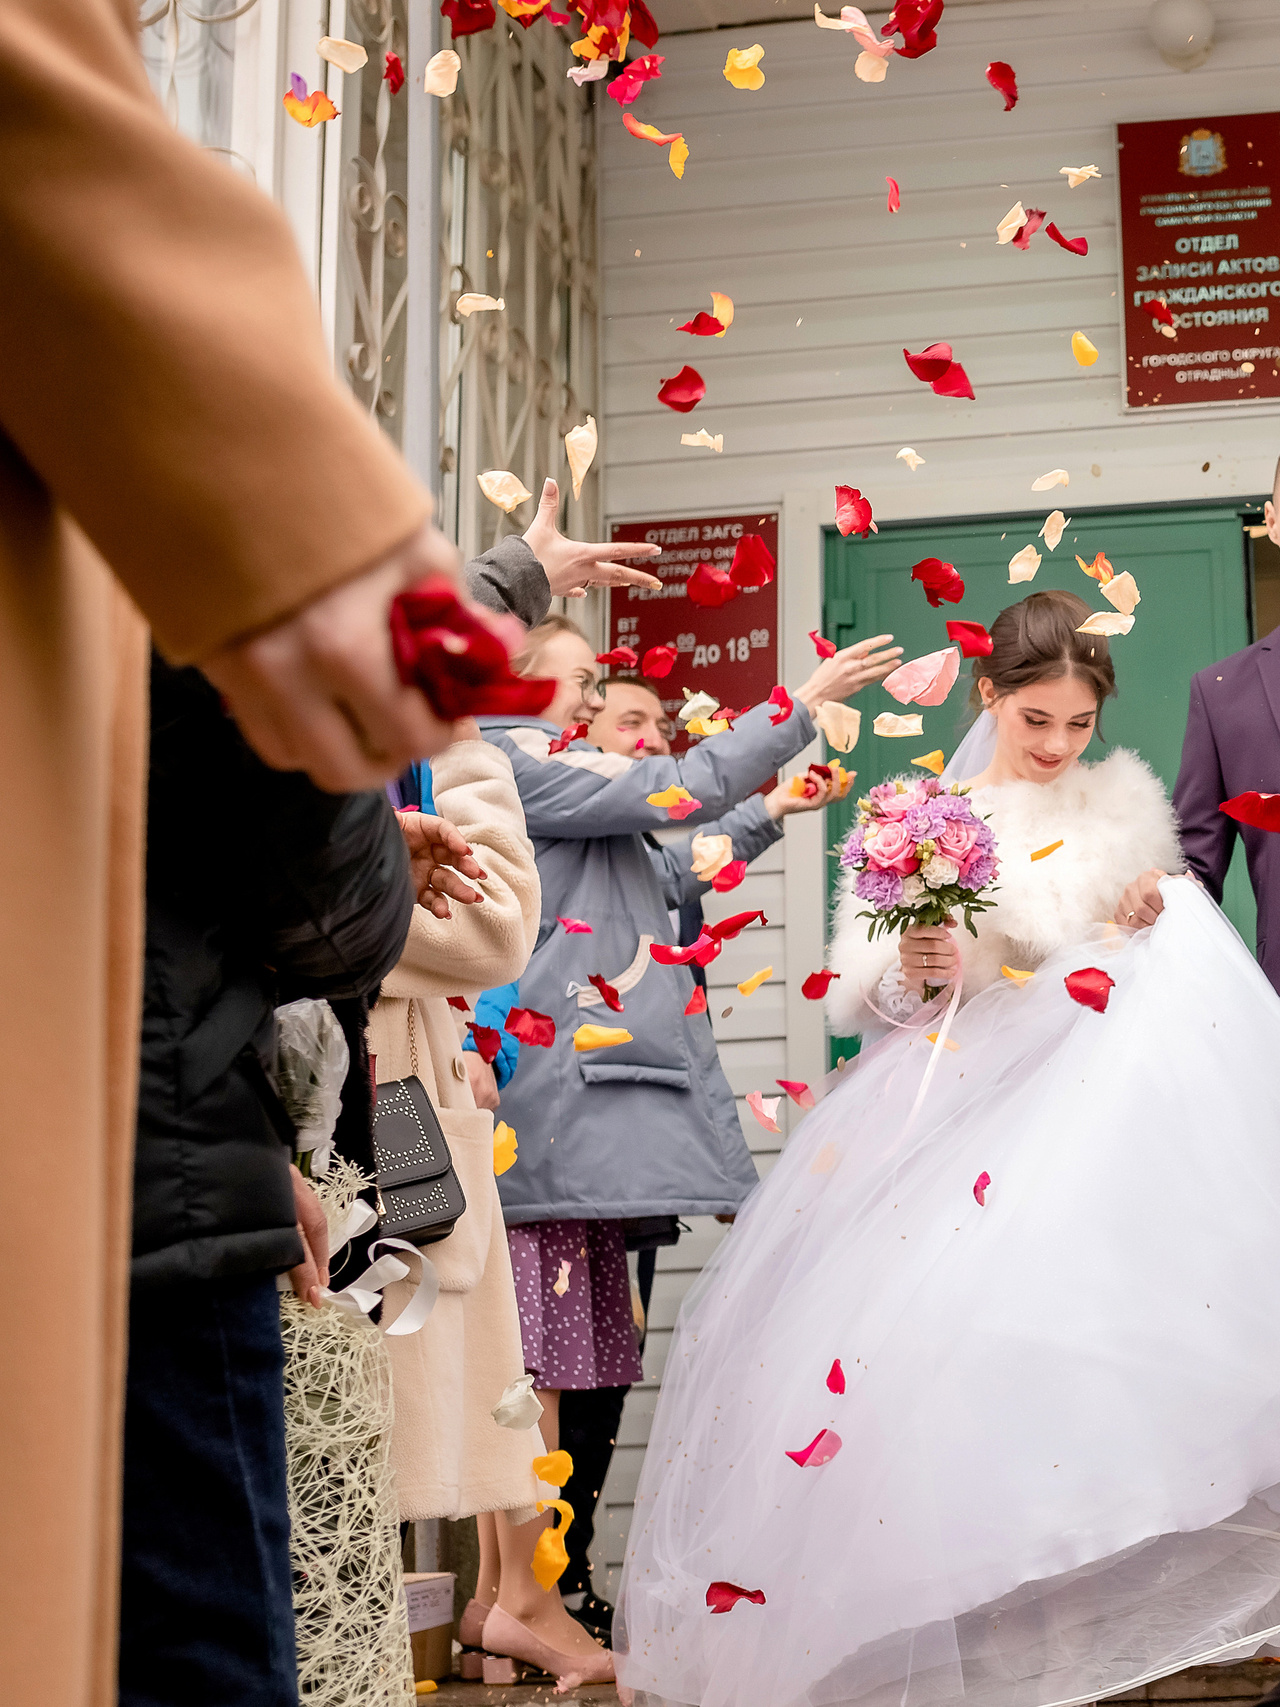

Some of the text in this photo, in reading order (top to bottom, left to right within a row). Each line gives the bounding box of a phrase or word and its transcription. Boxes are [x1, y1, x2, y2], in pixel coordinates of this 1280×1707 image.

[1175, 234, 1239, 254] ОТДЕЛ
[1136, 256, 1280, 282] ЗАПИСИ АКТОВ
[1142, 349, 1231, 368] ГОРОДСКОГО
[645, 523, 744, 544] ОТДЕЛ ЗАГС
[617, 616, 639, 633] ВТ
